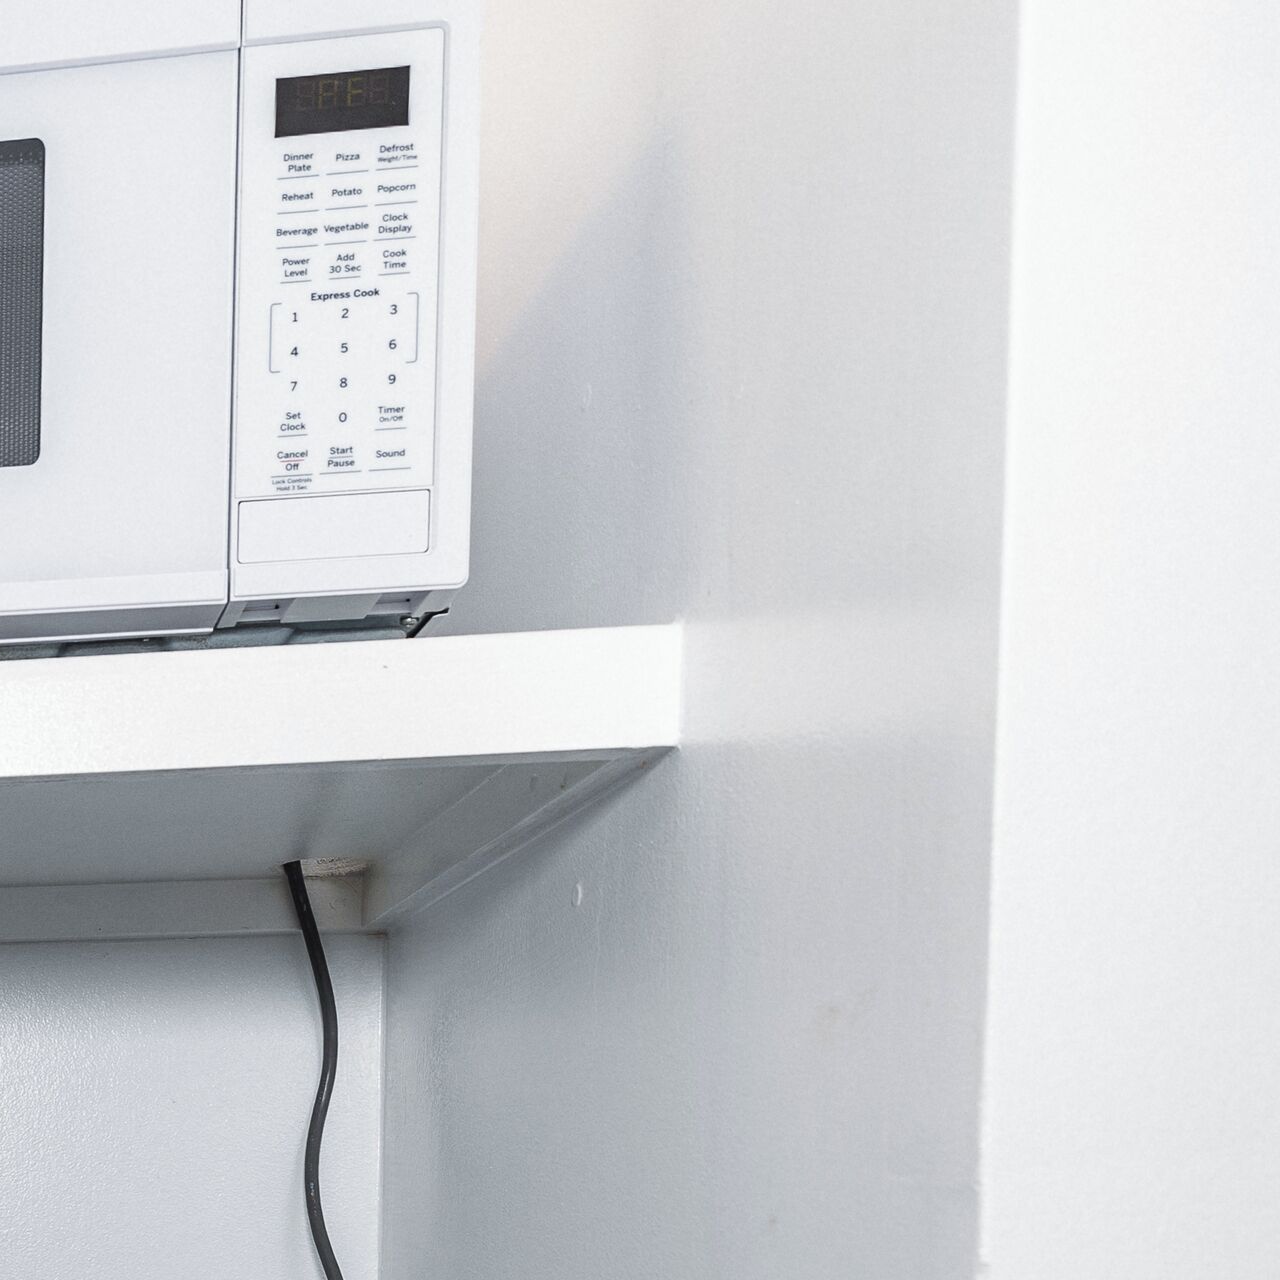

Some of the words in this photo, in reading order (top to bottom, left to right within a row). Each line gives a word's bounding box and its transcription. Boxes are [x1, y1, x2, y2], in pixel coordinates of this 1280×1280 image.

[379, 143, 414, 154] Defrost
[283, 152, 314, 163] Dinner
[335, 153, 361, 162] Pizza
[377, 154, 418, 164] Weight/Time
[287, 163, 312, 173] Plate
[331, 187, 363, 197] Potato
[376, 183, 417, 194] Popcorn
[281, 191, 314, 202] Reheat
[381, 212, 409, 223] Clock
[276, 226, 319, 237] Beverage
[323, 222, 370, 234] Vegetable
[378, 224, 413, 234] Display
[336, 253, 355, 262] Add
[382, 248, 407, 259] Cook
[282, 257, 311, 267] Power
[383, 260, 407, 269] Time
[284, 268, 308, 278] Level
[328, 264, 342, 274] 30
[344, 263, 362, 273] Sec
[310, 291, 351, 302] Express
[353, 287, 380, 298] Cook
[340, 307, 350, 319] 2
[389, 303, 398, 316] 3
[292, 311, 299, 323] 1
[340, 342, 349, 354] 5
[388, 338, 398, 350] 6
[290, 346, 299, 357] 4
[339, 376, 348, 389] 8
[387, 373, 397, 385] 9
[290, 380, 298, 392] 7
[377, 405, 406, 414] Timer
[285, 411, 301, 421] Set
[338, 411, 348, 423] 0
[378, 414, 404, 423] On/Off
[279, 422, 306, 432] Clock
[276, 449, 309, 460] Cancel
[330, 446, 354, 456] Start
[375, 448, 406, 459] Sound
[284, 462, 299, 472] Off
[327, 456, 356, 468] Pause
